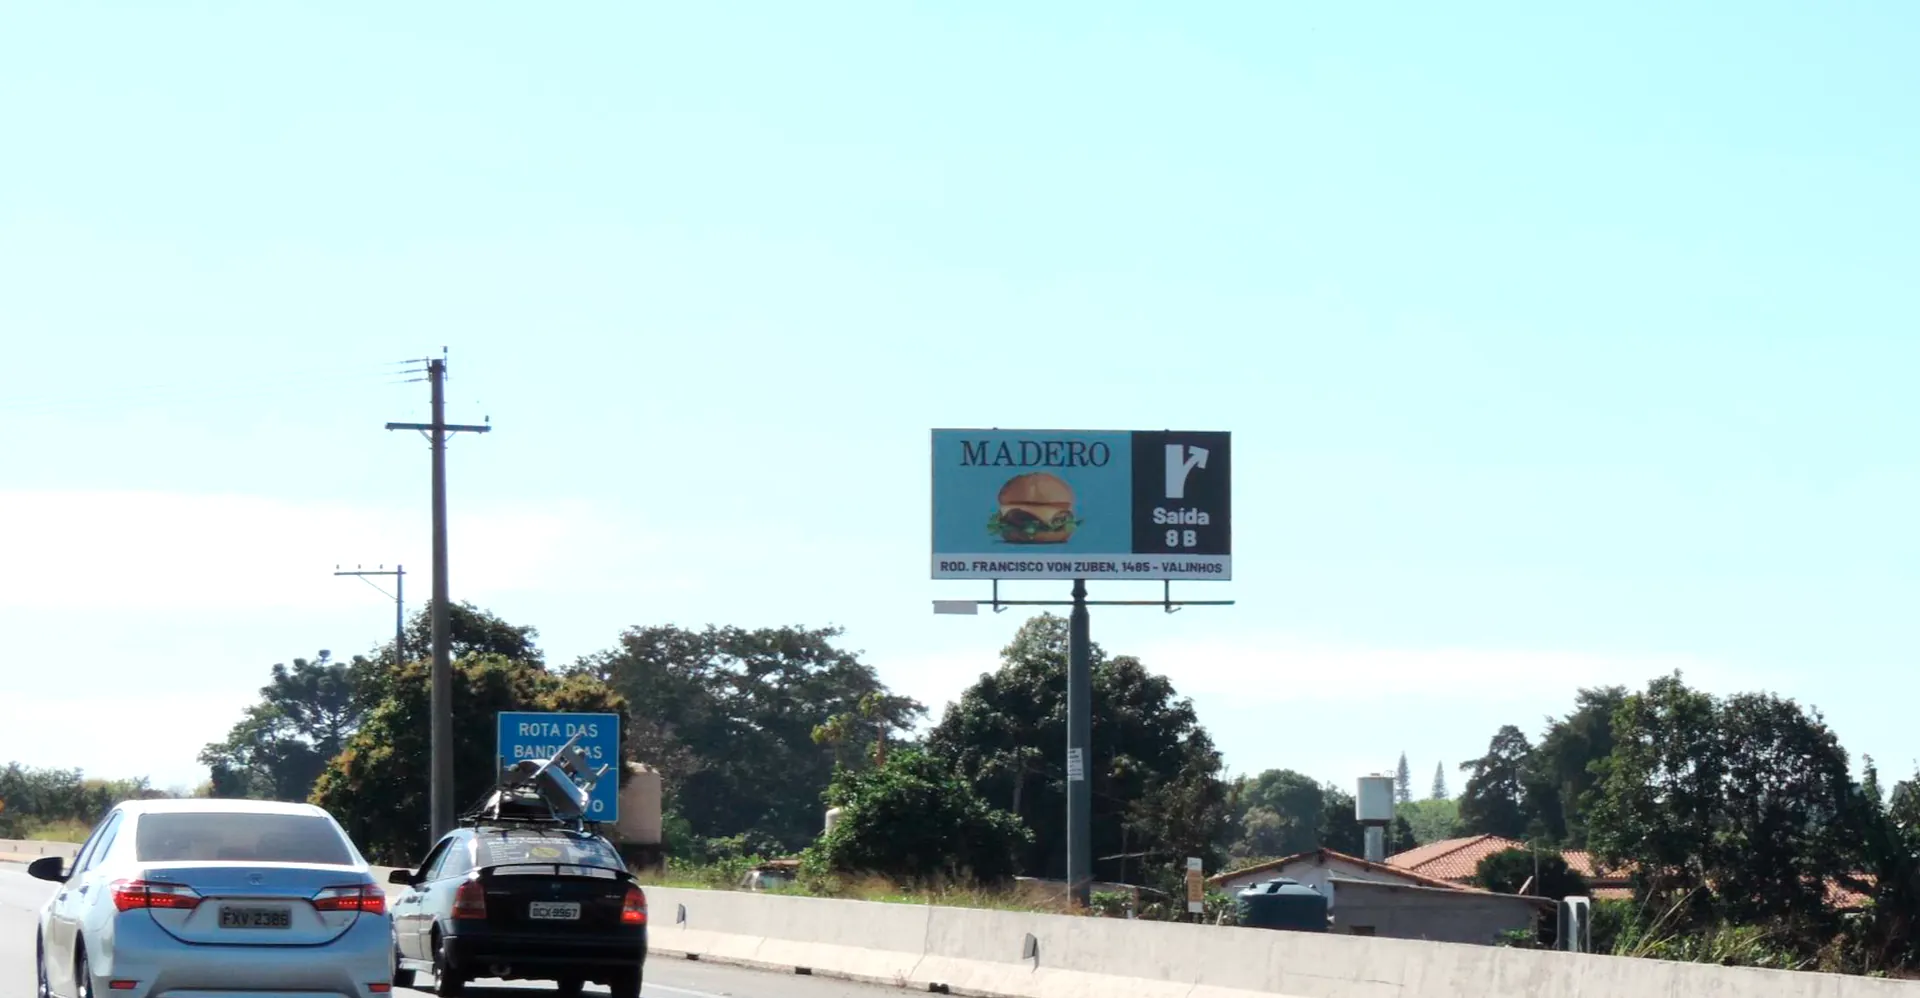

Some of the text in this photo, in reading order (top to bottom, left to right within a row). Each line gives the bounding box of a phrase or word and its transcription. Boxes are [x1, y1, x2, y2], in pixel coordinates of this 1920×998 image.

[959, 440, 1111, 468] MADERO
[1152, 506, 1210, 526] Saída
[1165, 530, 1197, 547] 8 B
[940, 561, 969, 572] ROD.
[972, 561, 1044, 573] FRANCISCO
[1046, 561, 1072, 573] VON
[1074, 561, 1119, 574] ZUBEN,
[1161, 562, 1223, 574] VALINHOS
[519, 723, 598, 738] ROTA DAS
[513, 744, 602, 759] BANDAS
